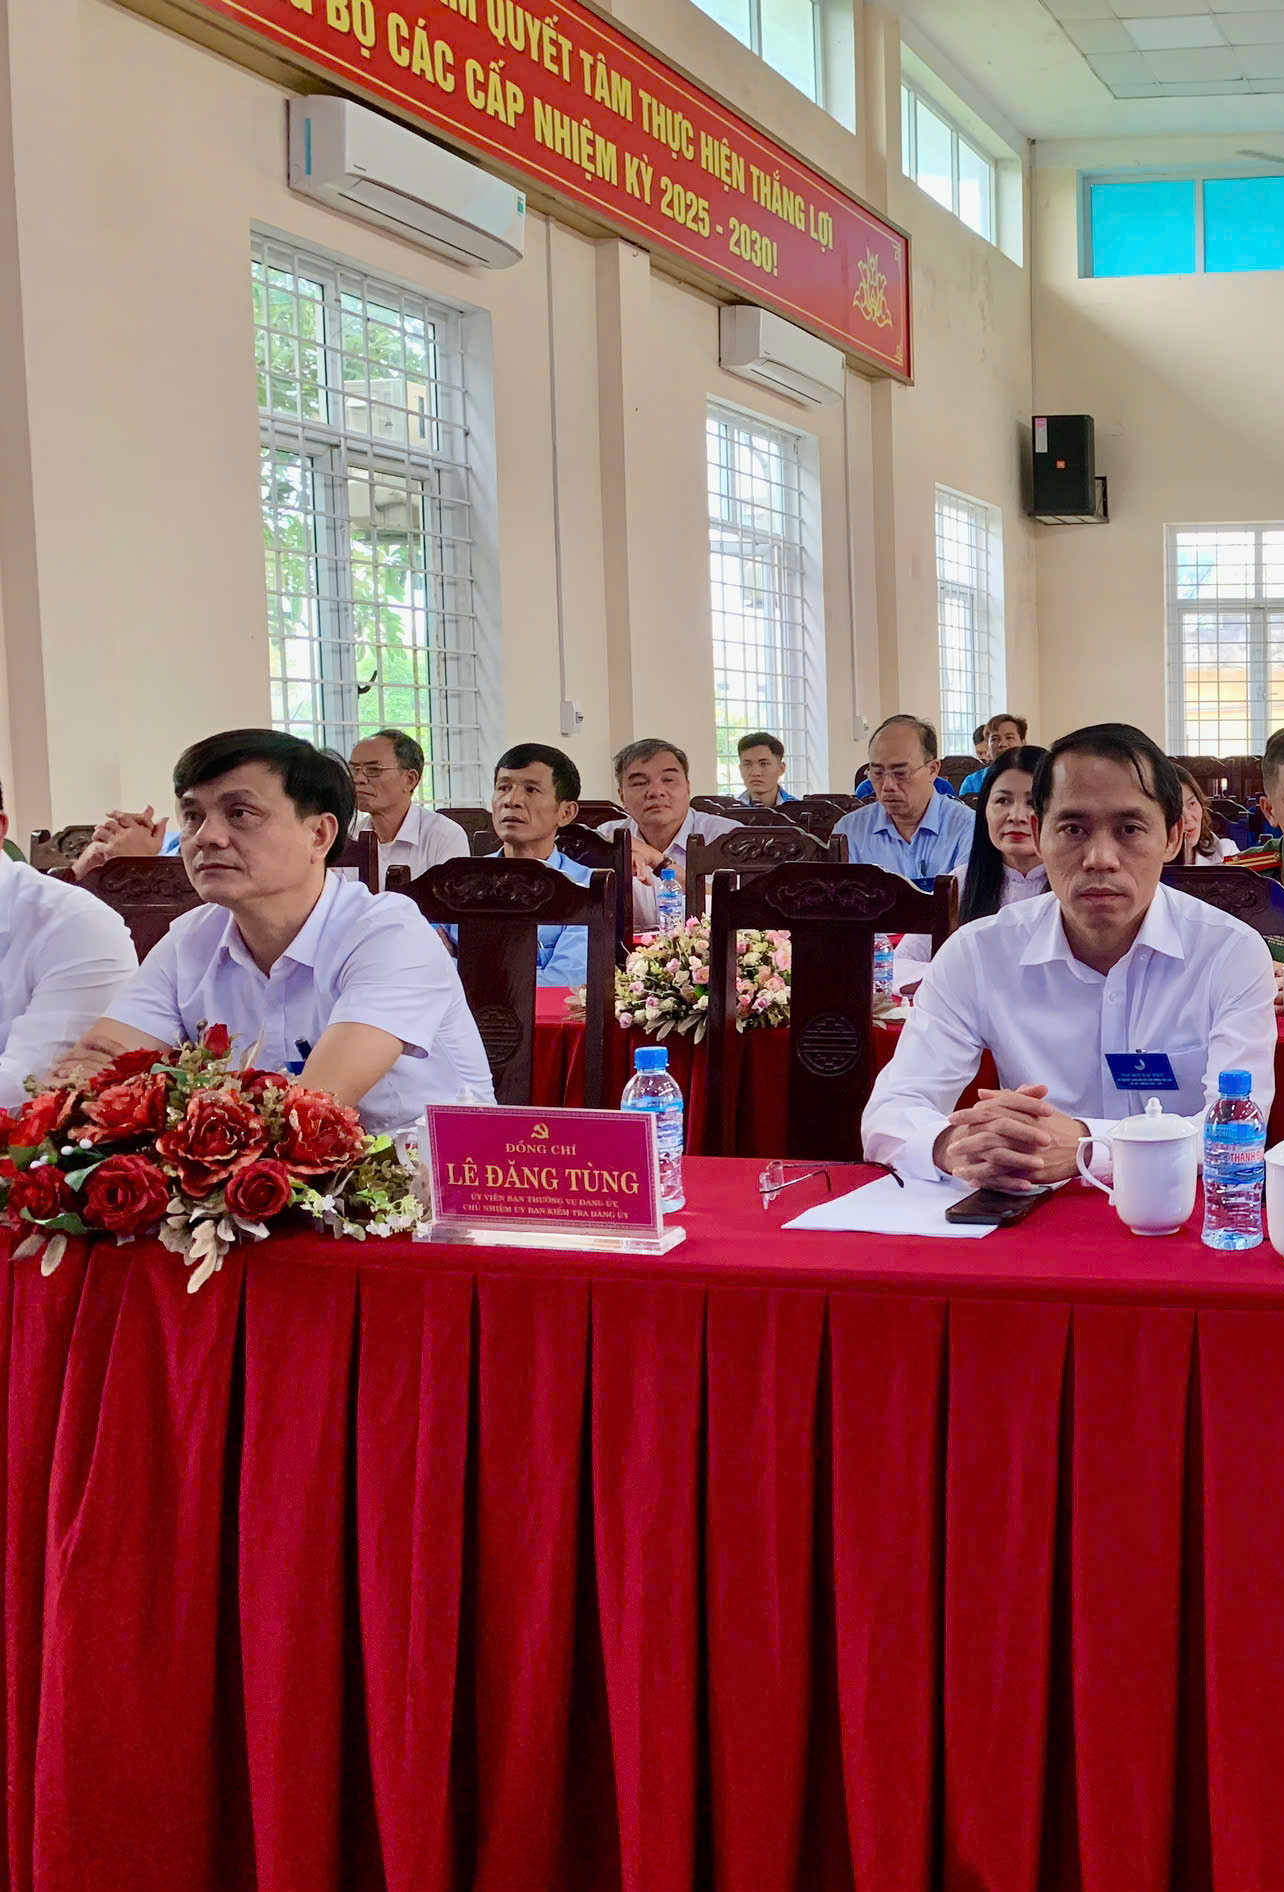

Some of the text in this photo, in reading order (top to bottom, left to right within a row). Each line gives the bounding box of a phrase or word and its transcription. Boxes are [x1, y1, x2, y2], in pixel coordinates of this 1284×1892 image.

[487, 0, 833, 252] QUYẾT TÂM THỰC HIỆN THẮNG LỢI
[387, 12, 455, 92] CÁC
[465, 58, 524, 128] CẤP
[533, 96, 618, 187] NHIỆM
[624, 152, 653, 205] KỲ
[660, 176, 710, 238] 2025
[715, 224, 724, 234] -
[729, 217, 778, 277] 2030!
[550, 1144, 576, 1156] CHÍ
[447, 1157, 640, 1194] LÊ ĐĂNG TÙNG
[506, 1194, 525, 1203] BAN
[527, 1207, 545, 1215] BAN
[572, 1209, 589, 1217] TRA
